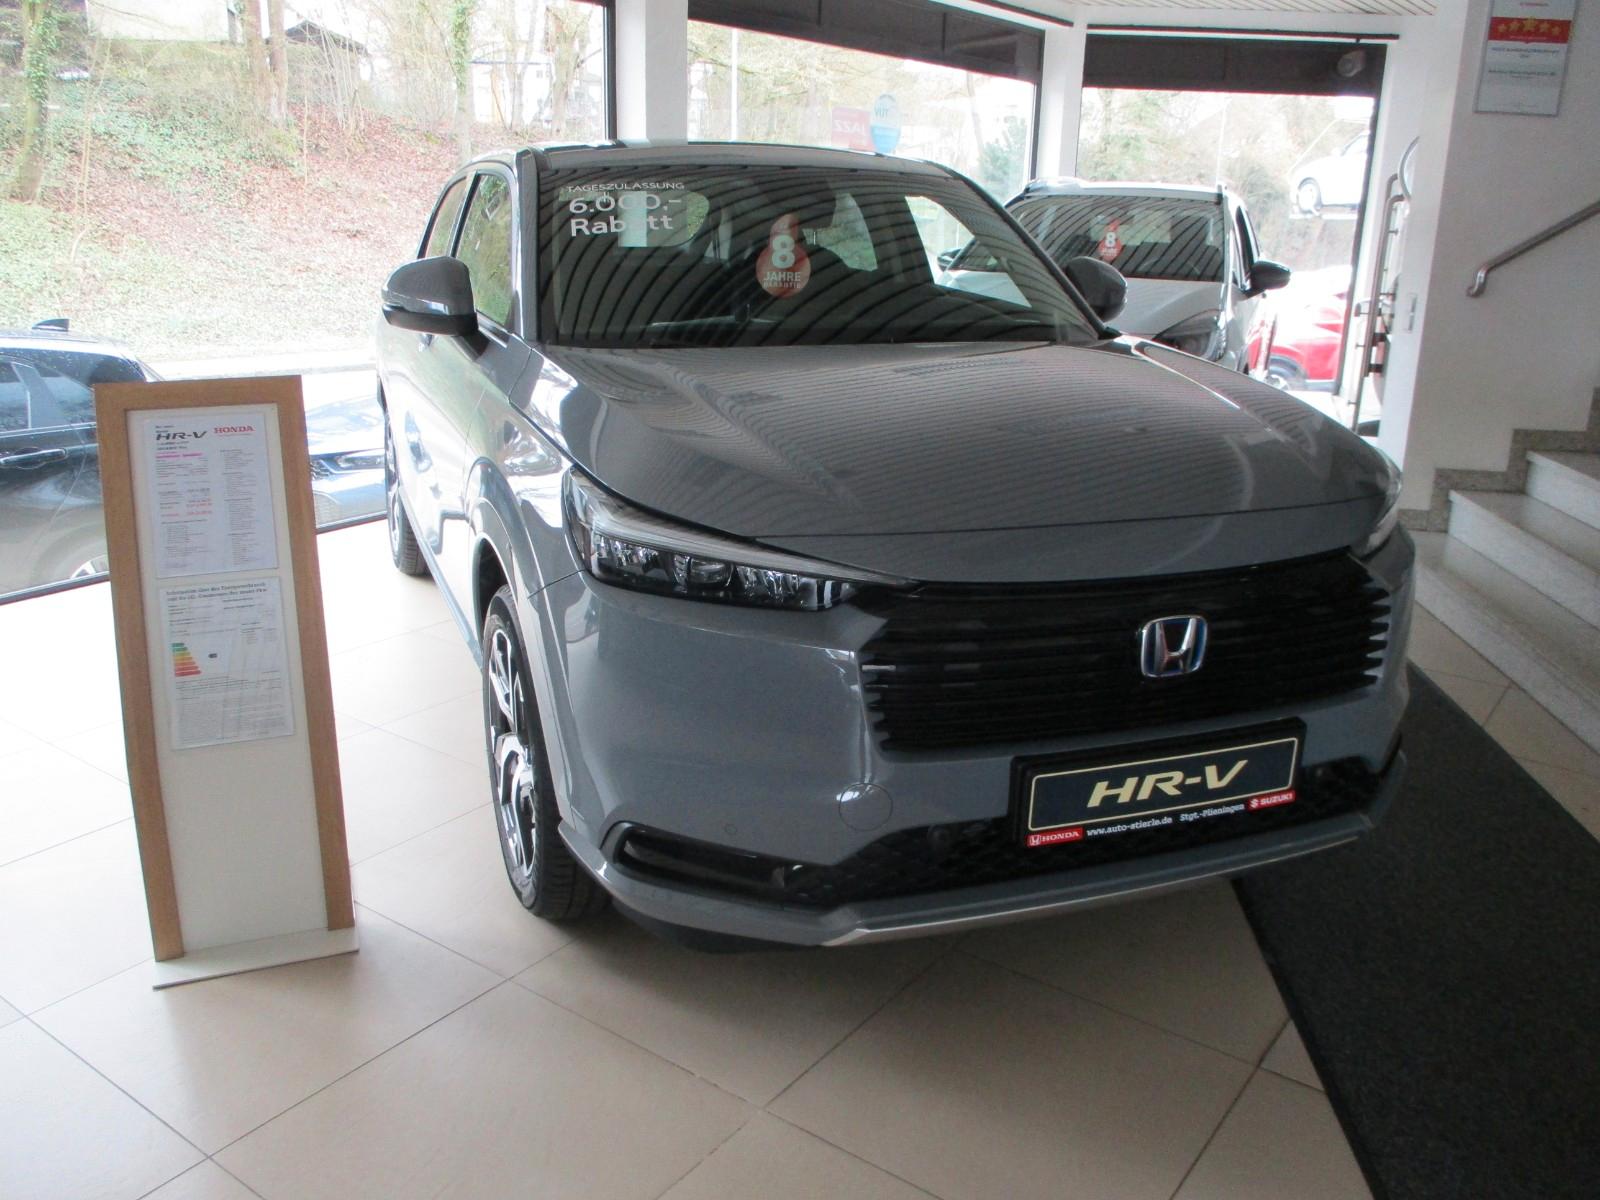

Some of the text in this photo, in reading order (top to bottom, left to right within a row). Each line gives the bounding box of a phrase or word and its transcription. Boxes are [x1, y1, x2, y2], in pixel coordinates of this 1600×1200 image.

[566, 182, 686, 193] TAGESZULASSUNG
[570, 215, 674, 237] Rabtt
[1105, 231, 1117, 247] 8
[772, 234, 796, 269] 8
[763, 271, 801, 282] JAHRE
[156, 430, 208, 441] HR-V
[213, 425, 256, 434] HONDA
[1086, 759, 1248, 808] HR-V
[1260, 793, 1294, 806] SUZUKI
[1086, 815, 1173, 837] www.auto-stierle.de
[1042, 831, 1080, 843] HONDA
